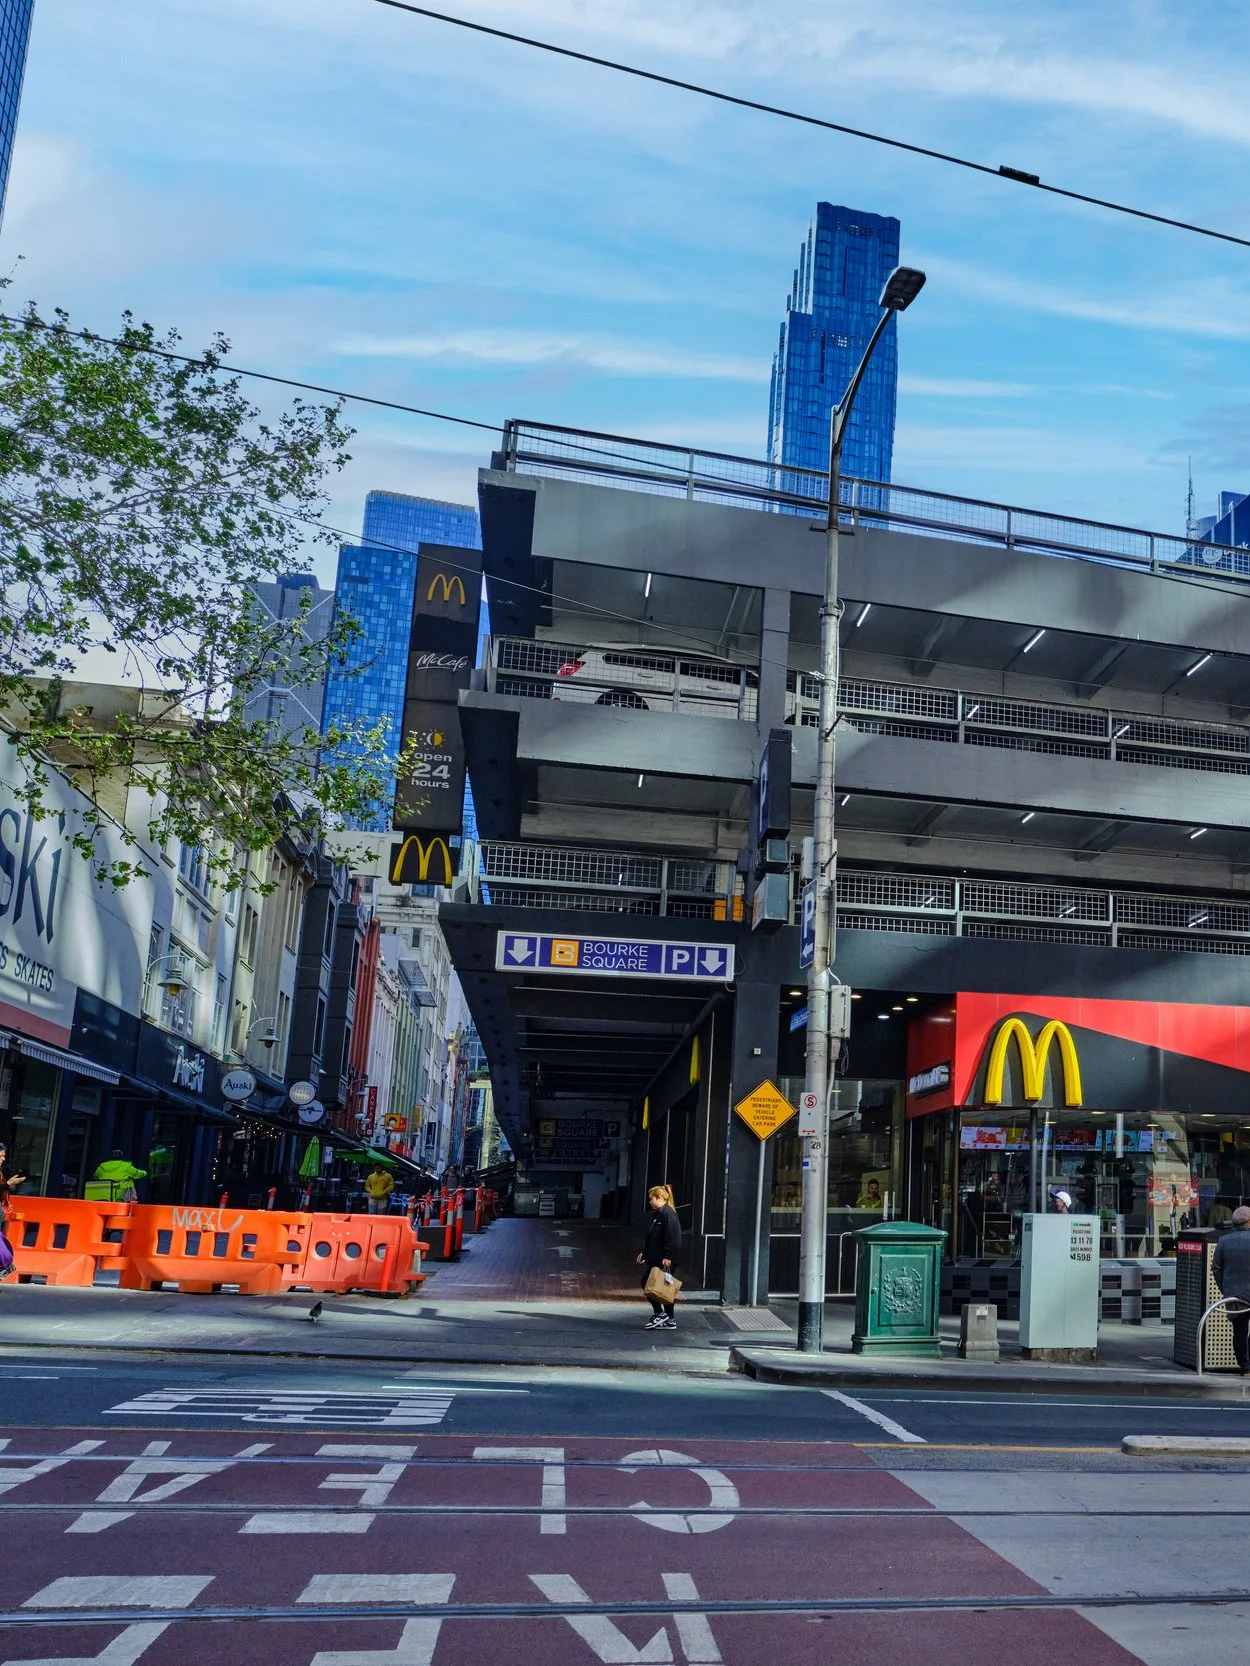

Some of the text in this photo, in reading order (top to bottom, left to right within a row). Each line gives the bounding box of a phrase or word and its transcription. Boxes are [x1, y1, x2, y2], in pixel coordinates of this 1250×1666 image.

[414, 752, 452, 764] open
[411, 764, 451, 779] 24
[411, 777, 450, 789] hours
[804, 892, 815, 938] P
[583, 942, 648, 958] BOURKE
[582, 955, 648, 970] SQUARE
[672, 949, 690, 970] P
[14, 953, 54, 992] SKATES
[224, 1078, 252, 1090] Auski
